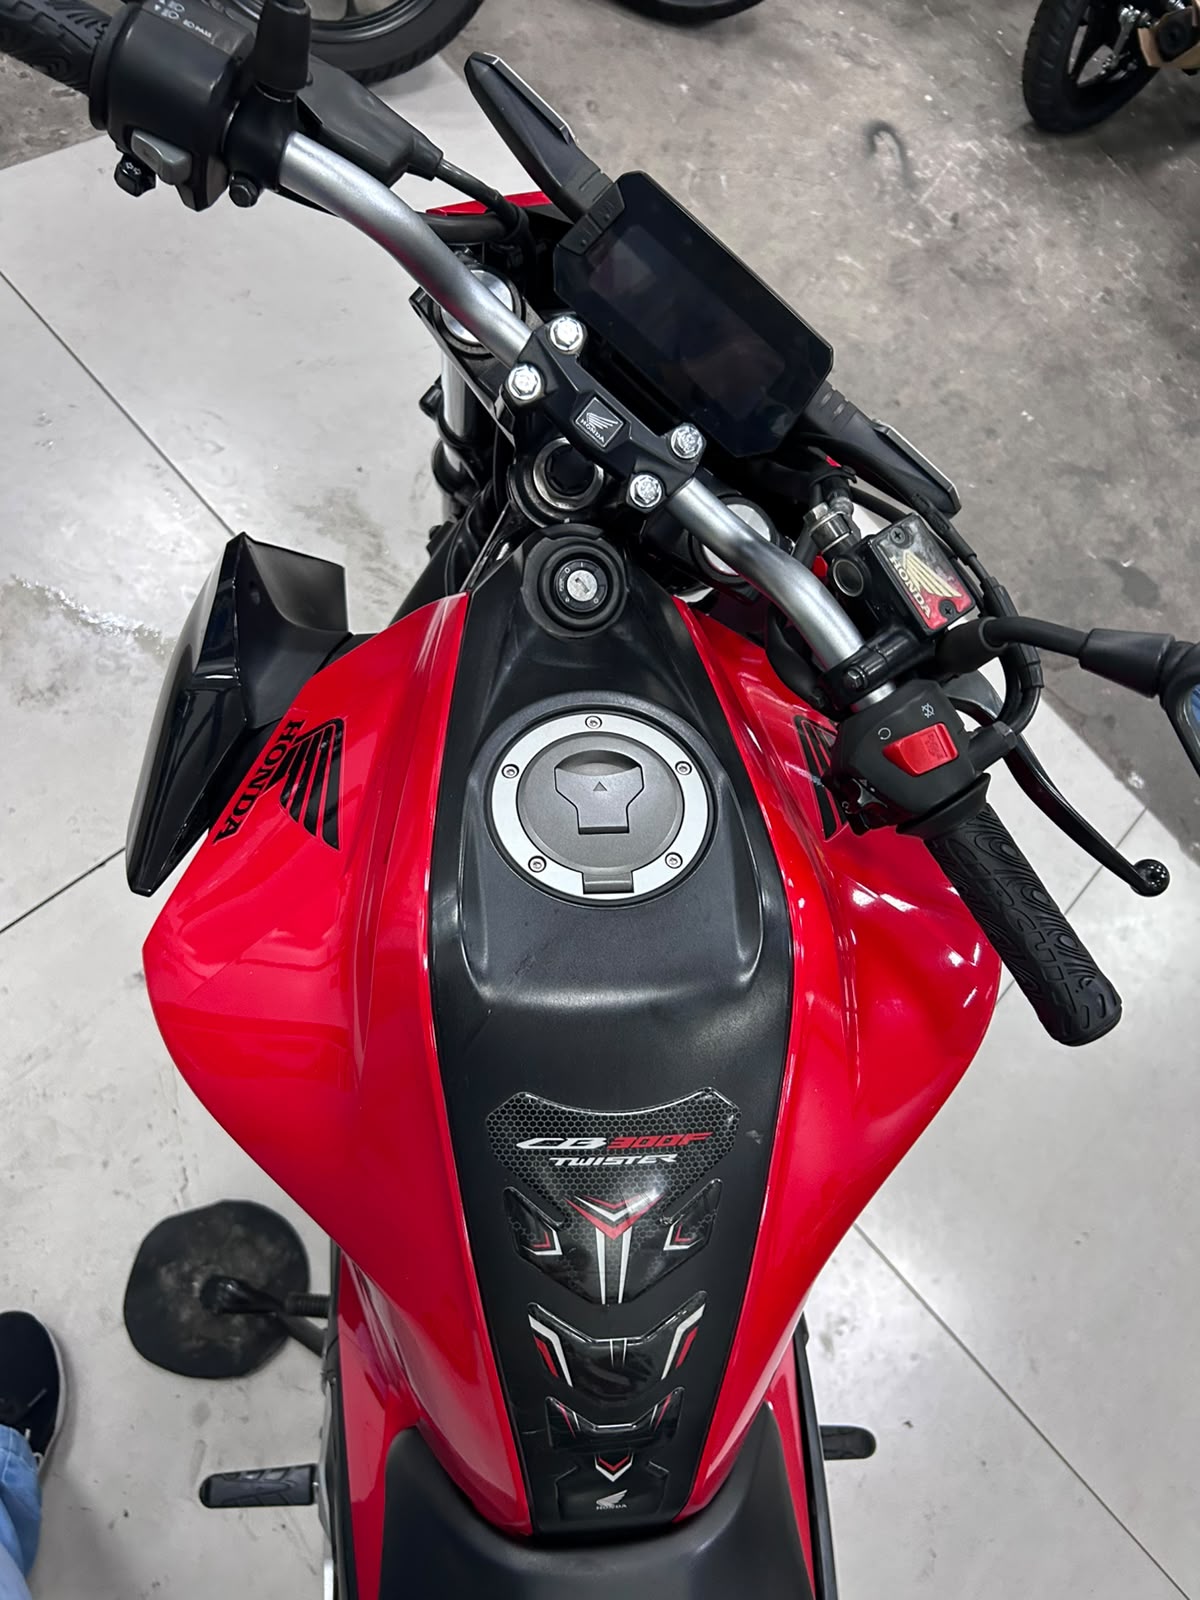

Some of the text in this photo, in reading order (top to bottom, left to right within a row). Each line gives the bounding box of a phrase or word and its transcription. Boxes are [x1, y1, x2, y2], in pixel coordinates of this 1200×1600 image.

[580, 419, 605, 443] HONDA
[889, 555, 931, 619] HONDA
[213, 719, 303, 842] HONDA
[549, 1154, 677, 1166] TWISTER
